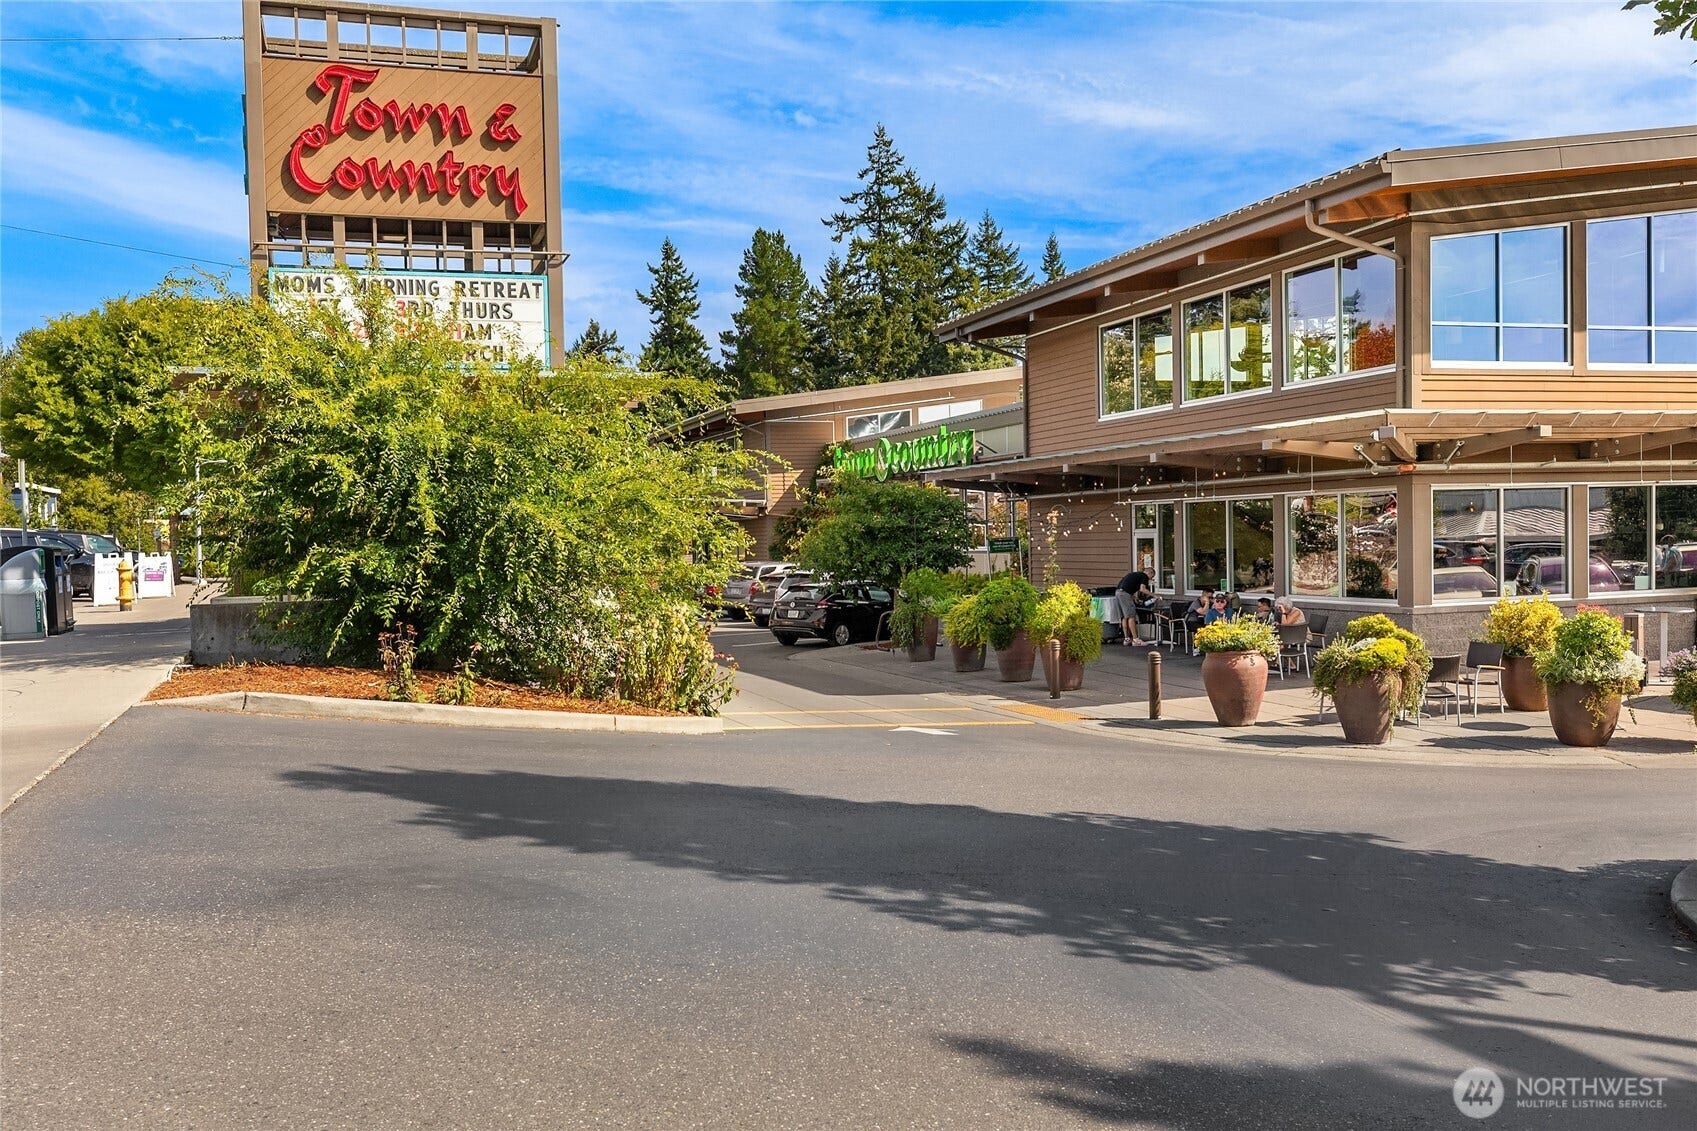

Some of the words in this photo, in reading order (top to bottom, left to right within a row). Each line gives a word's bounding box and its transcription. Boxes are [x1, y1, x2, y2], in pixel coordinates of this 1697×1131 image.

[315, 64, 472, 138] Town
[488, 103, 522, 143] &
[289, 123, 528, 217] Country
[275, 274, 334, 294] MOMS
[455, 280, 543, 299] RETREAT
